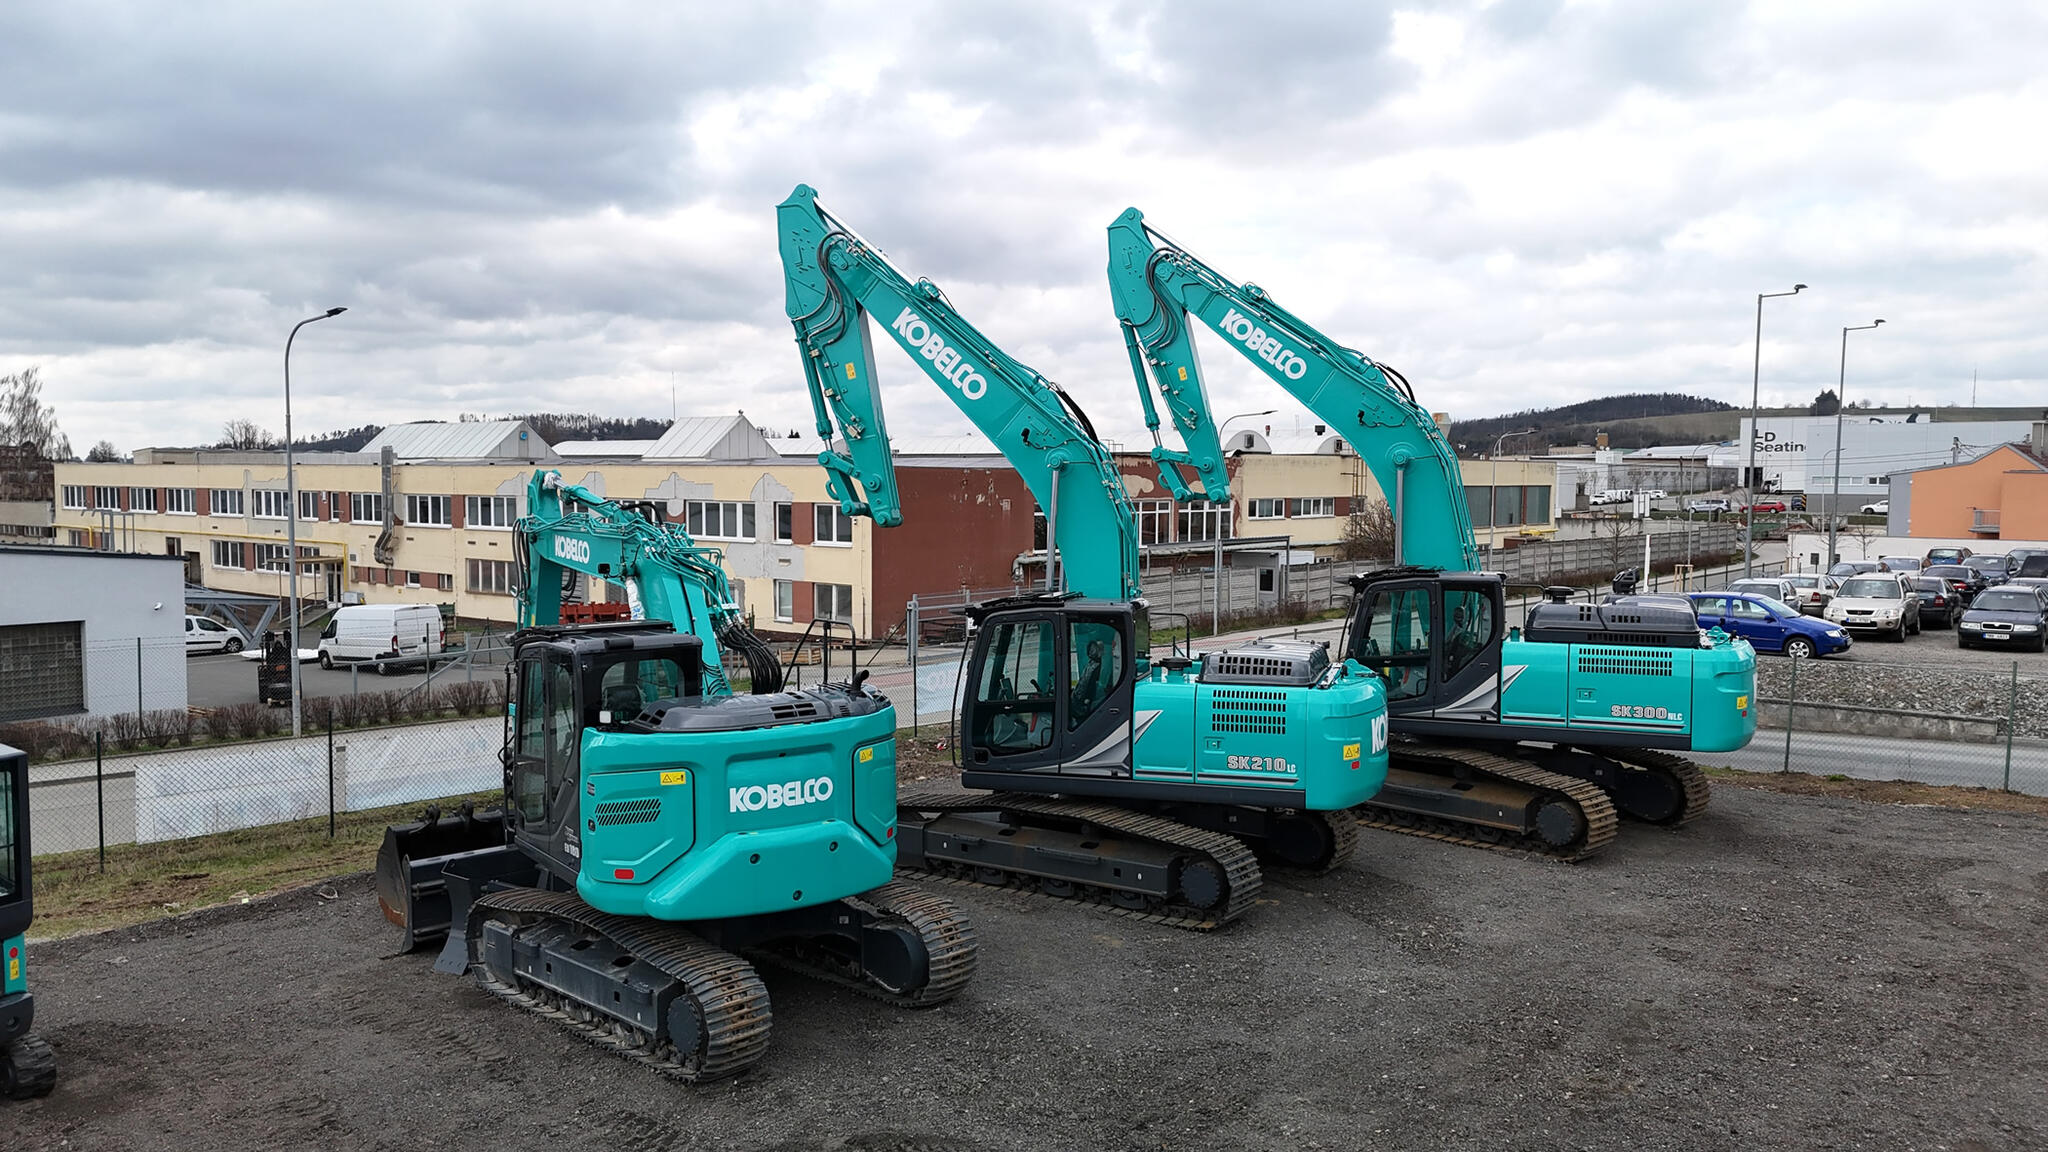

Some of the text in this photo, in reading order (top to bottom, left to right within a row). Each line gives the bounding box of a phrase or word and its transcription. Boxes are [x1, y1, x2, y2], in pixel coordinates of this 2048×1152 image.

[891, 306, 987, 400] KOBELCO
[1218, 308, 1307, 380] KOBELCO
[1754, 441, 1807, 452] Seatin
[554, 534, 590, 564] KOBELCO
[729, 776, 834, 813] KOBELCO
